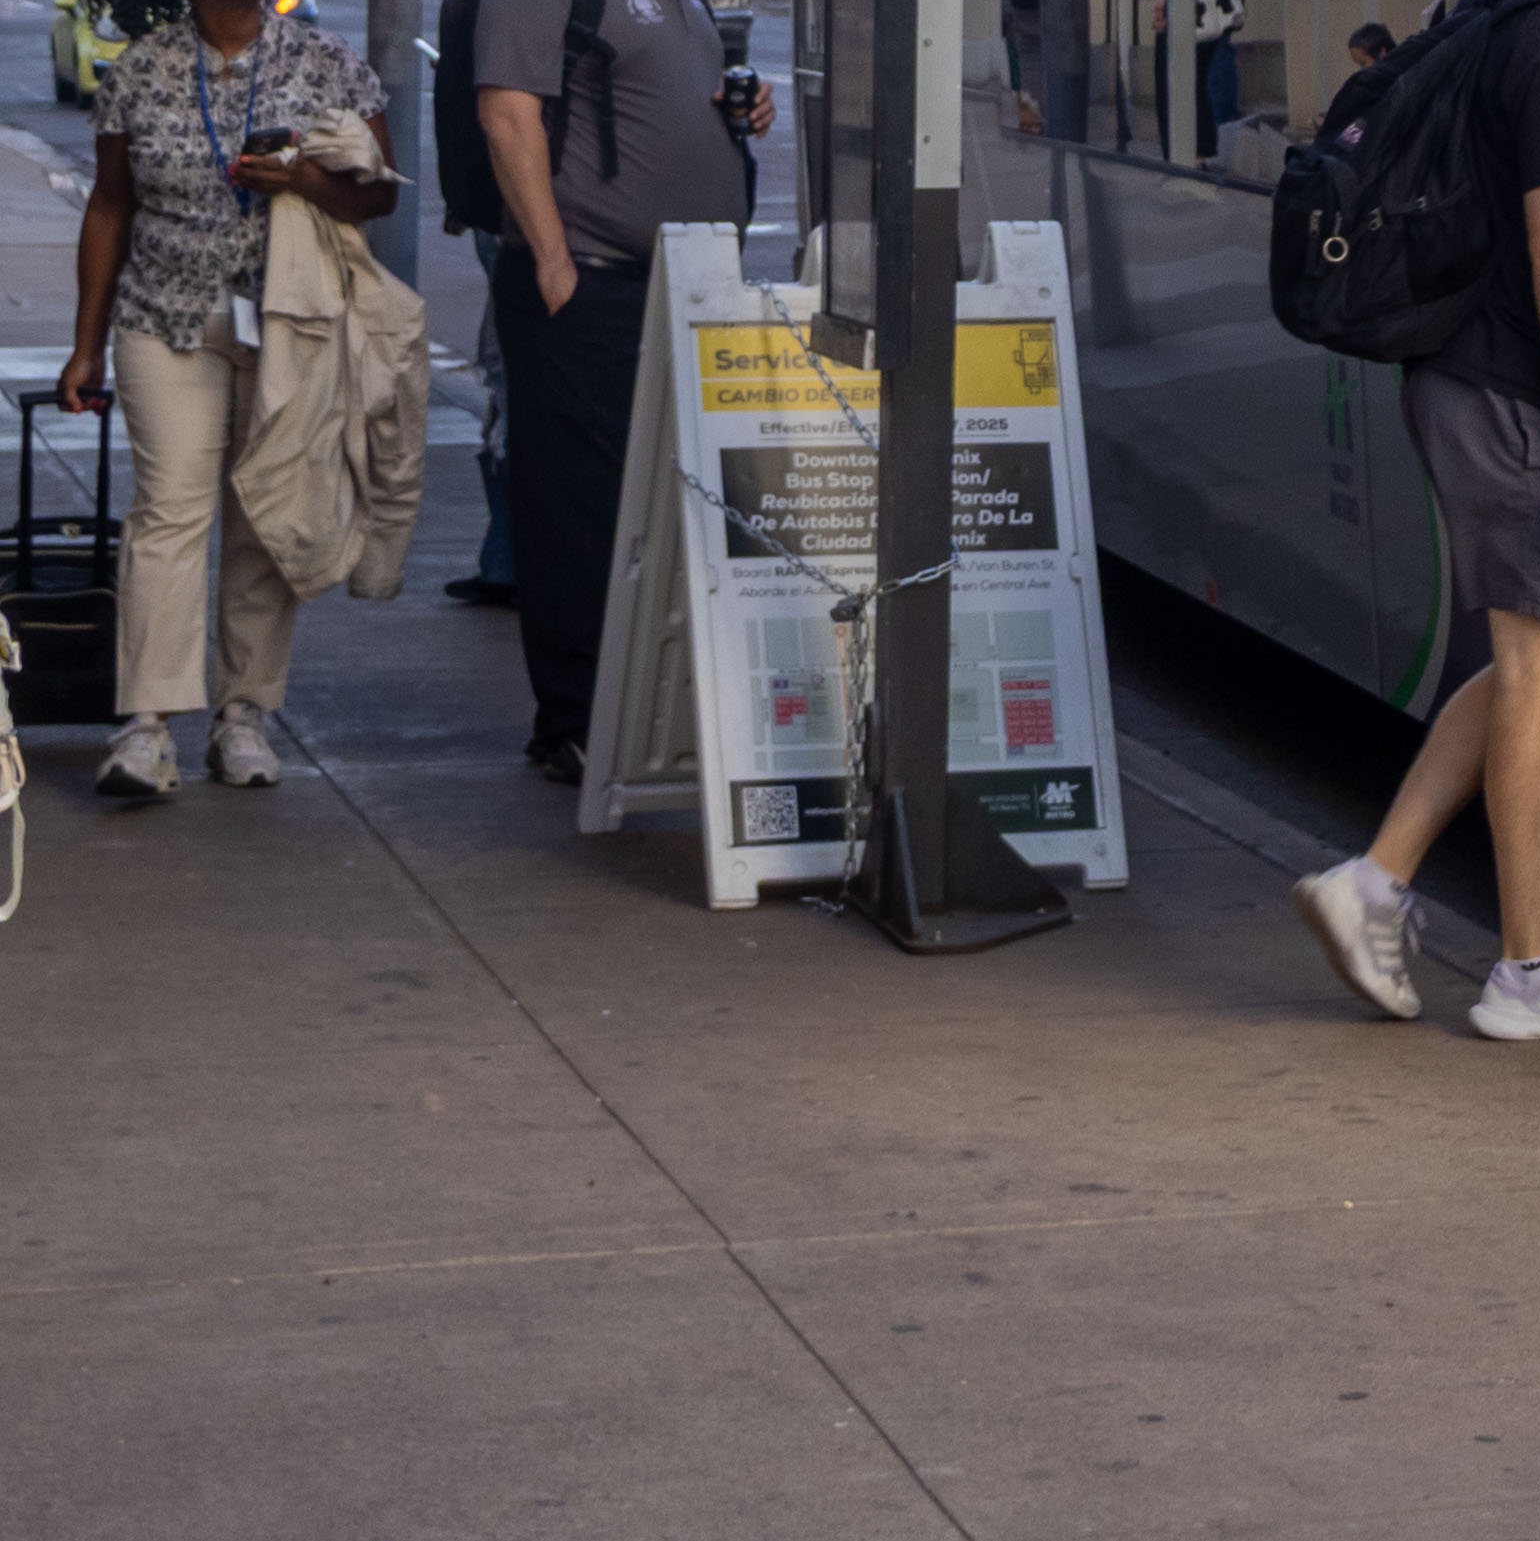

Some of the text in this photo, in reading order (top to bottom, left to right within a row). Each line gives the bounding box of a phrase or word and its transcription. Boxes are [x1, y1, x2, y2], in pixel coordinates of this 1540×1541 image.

[715, 348, 822, 371] Servic
[717, 387, 799, 404] CAMBIO
[966, 417, 1009, 431] 2025
[785, 472, 822, 489] Bus
[828, 471, 873, 491] Stop
[751, 515, 776, 531] De
[781, 511, 863, 530] Autobús
[977, 510, 1005, 525] De
[1008, 509, 1033, 525] La
[801, 531, 872, 551] Ciudad
[980, 578, 1026, 591] Central
